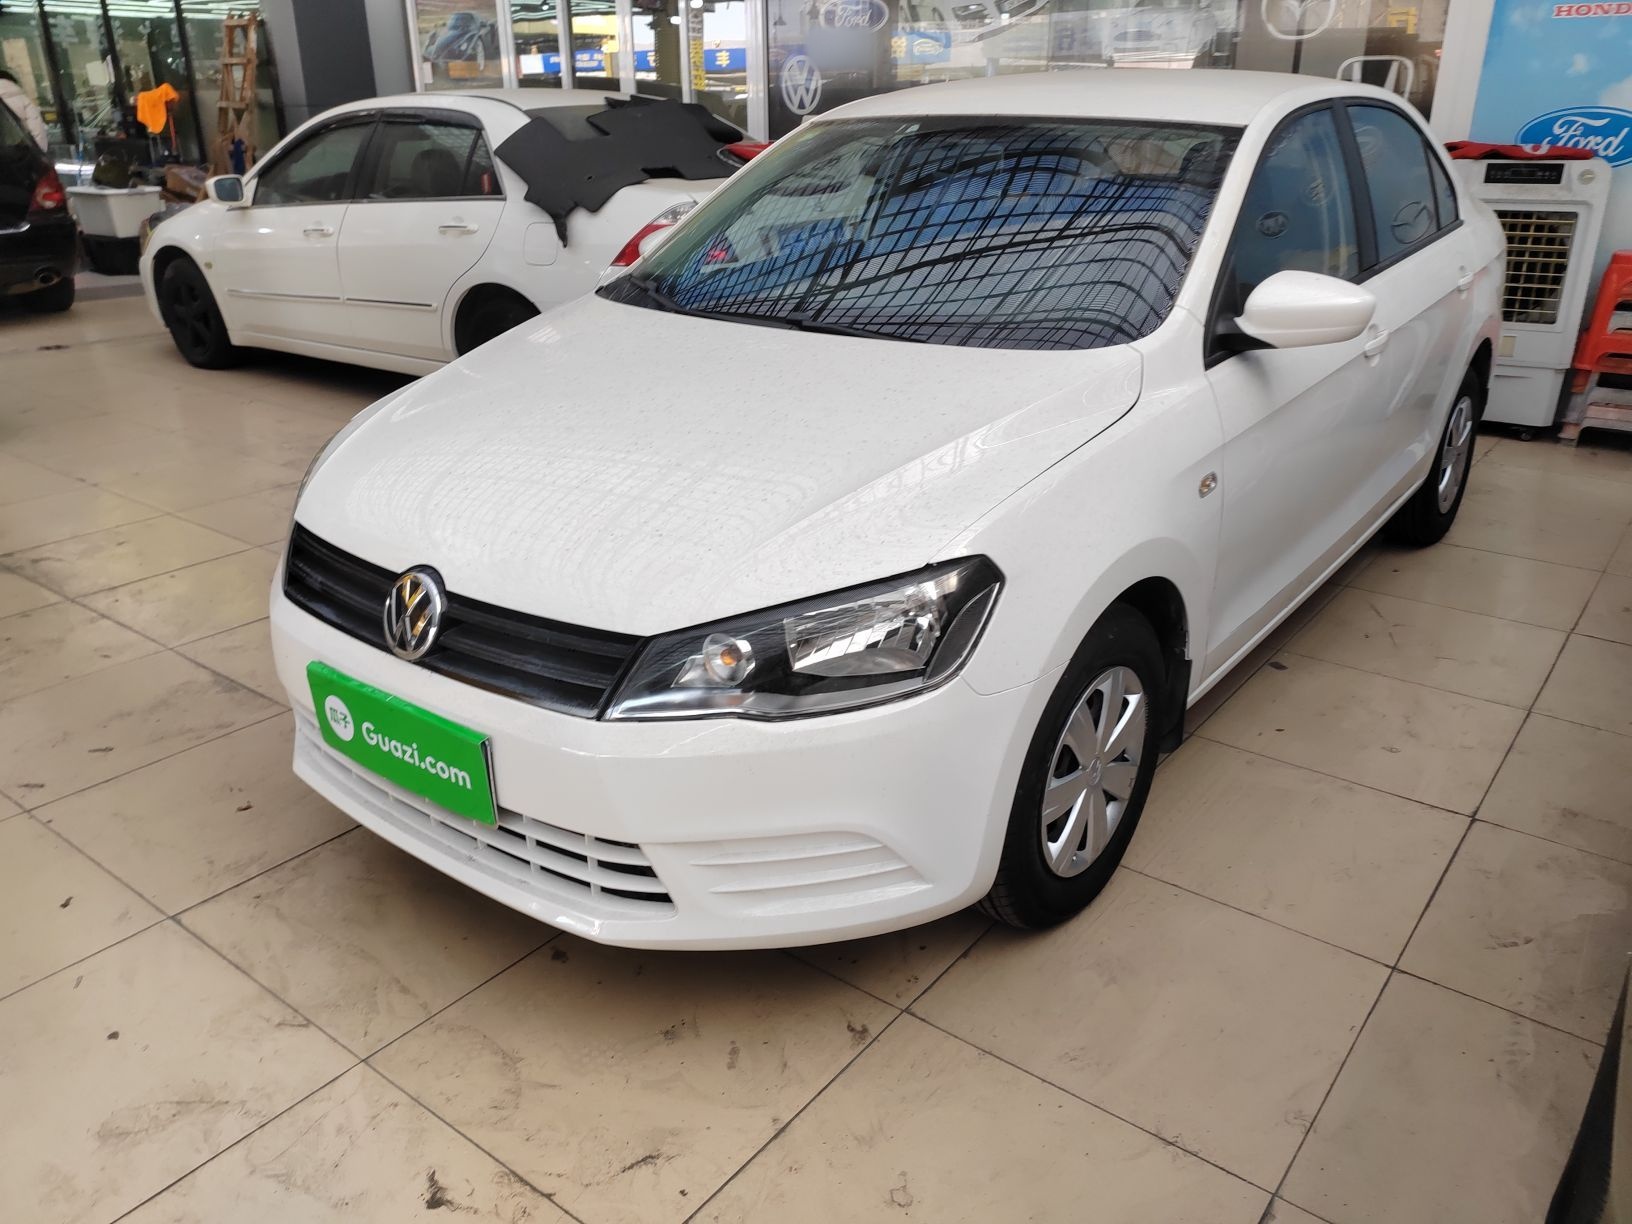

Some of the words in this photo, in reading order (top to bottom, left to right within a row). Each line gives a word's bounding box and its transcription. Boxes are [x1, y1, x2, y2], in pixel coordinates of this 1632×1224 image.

[834, 4, 872, 28] Ford
[1553, 3, 1632, 18] HOND
[1522, 115, 1630, 157] Ford
[361, 721, 472, 790] Guazi.com
